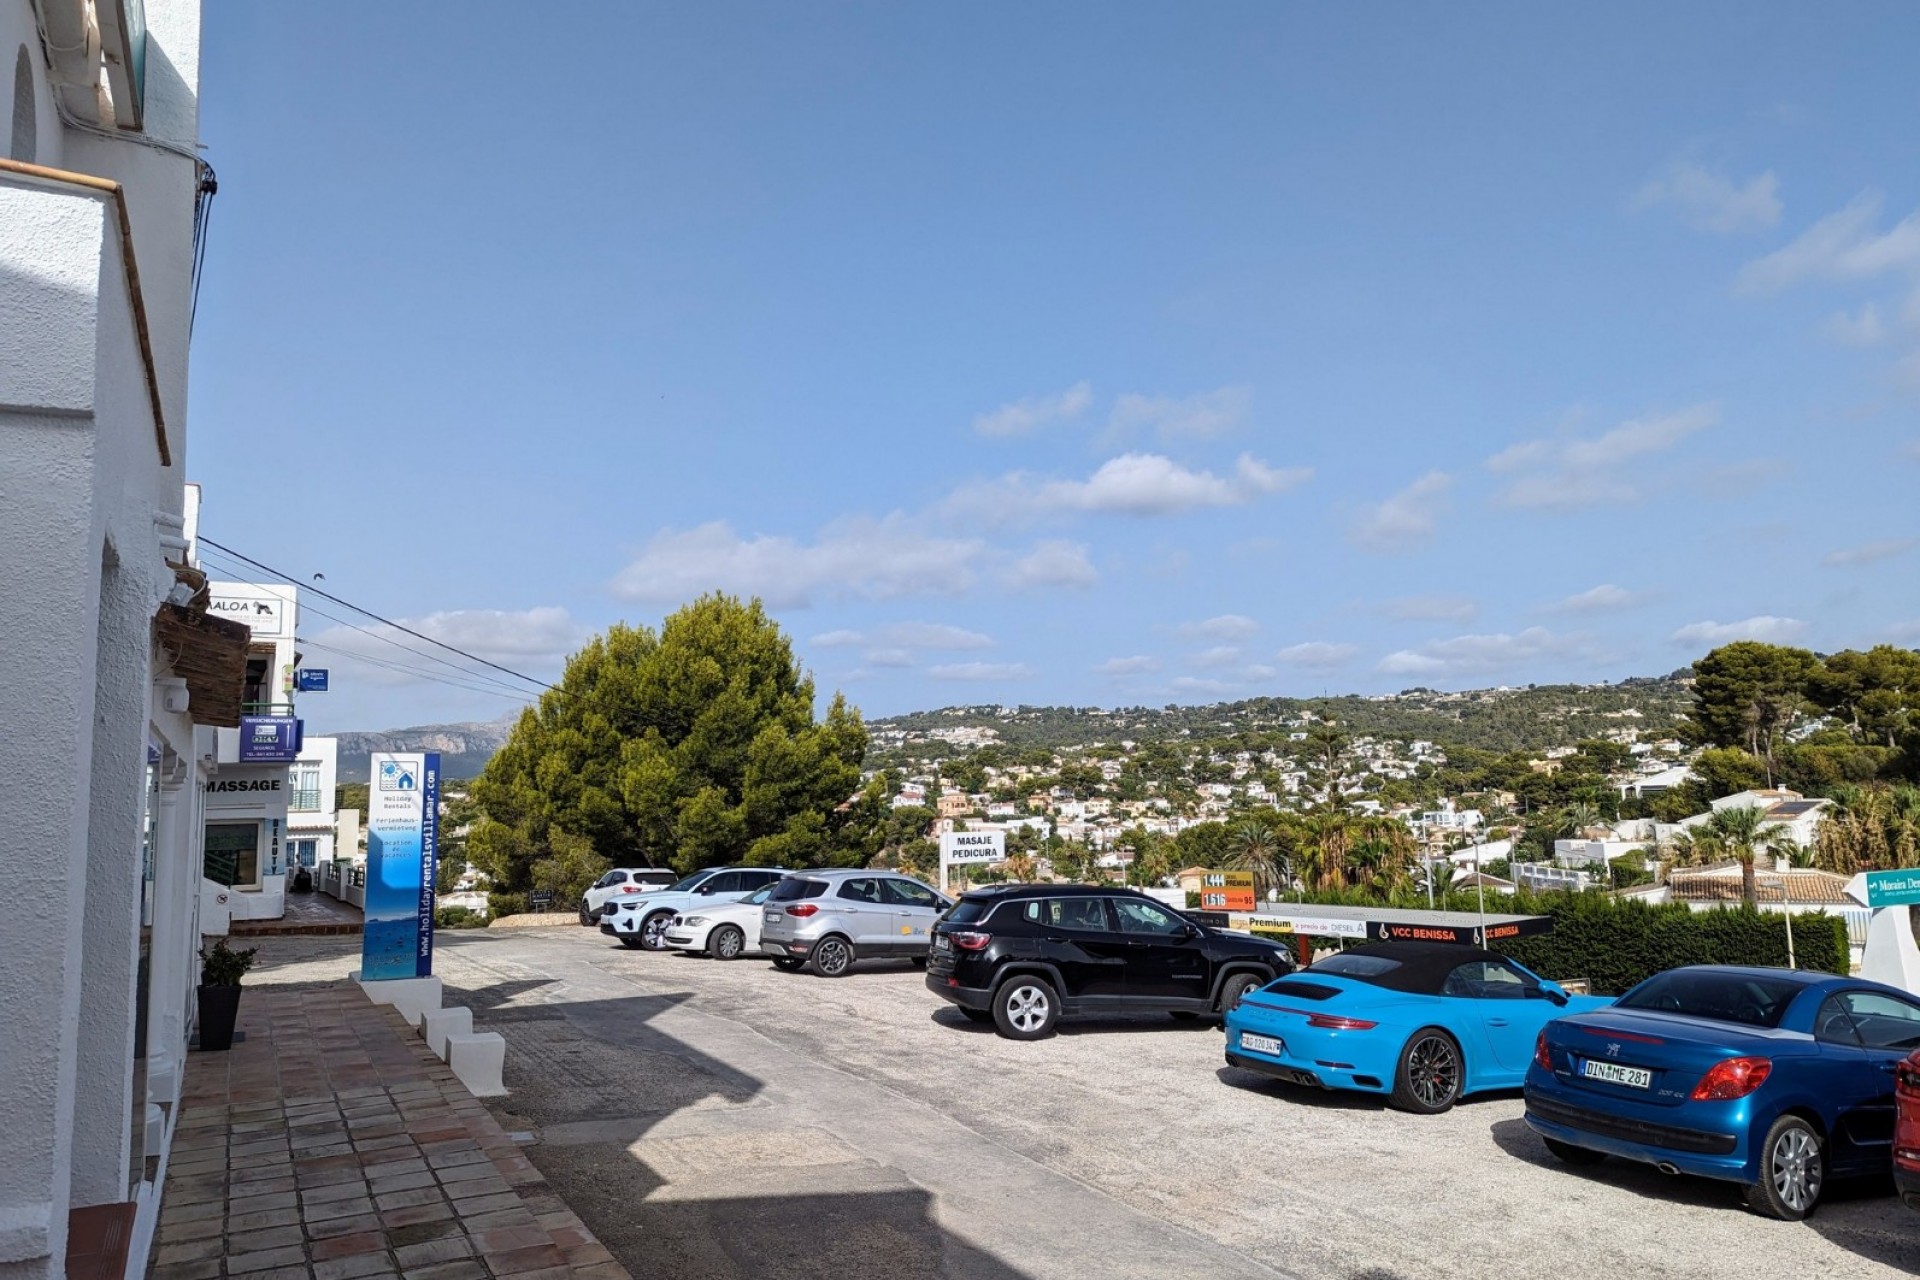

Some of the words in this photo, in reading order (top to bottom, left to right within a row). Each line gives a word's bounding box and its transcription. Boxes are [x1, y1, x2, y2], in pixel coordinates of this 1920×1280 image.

[206, 779, 281, 793] MASSAGE
[271, 818, 279, 875] BEAUTY
[957, 836, 992, 846] MASAJE
[952, 848, 997, 858] PEDICURA
[420, 769, 436, 957] www.holidayrentalsvillamar.com
[1244, 896, 1253, 905] 95
[1249, 916, 1292, 928] Premium
[1331, 923, 1354, 933] DIESEL
[1357, 922, 1365, 933] A
[1494, 926, 1519, 937] BENISSA
[1391, 927, 1411, 937] VCC
[1413, 928, 1456, 941] BENISSA
[1586, 1062, 1605, 1078] DIN
[1612, 1066, 1626, 1081] ME
[1628, 1070, 1649, 1086] 281
